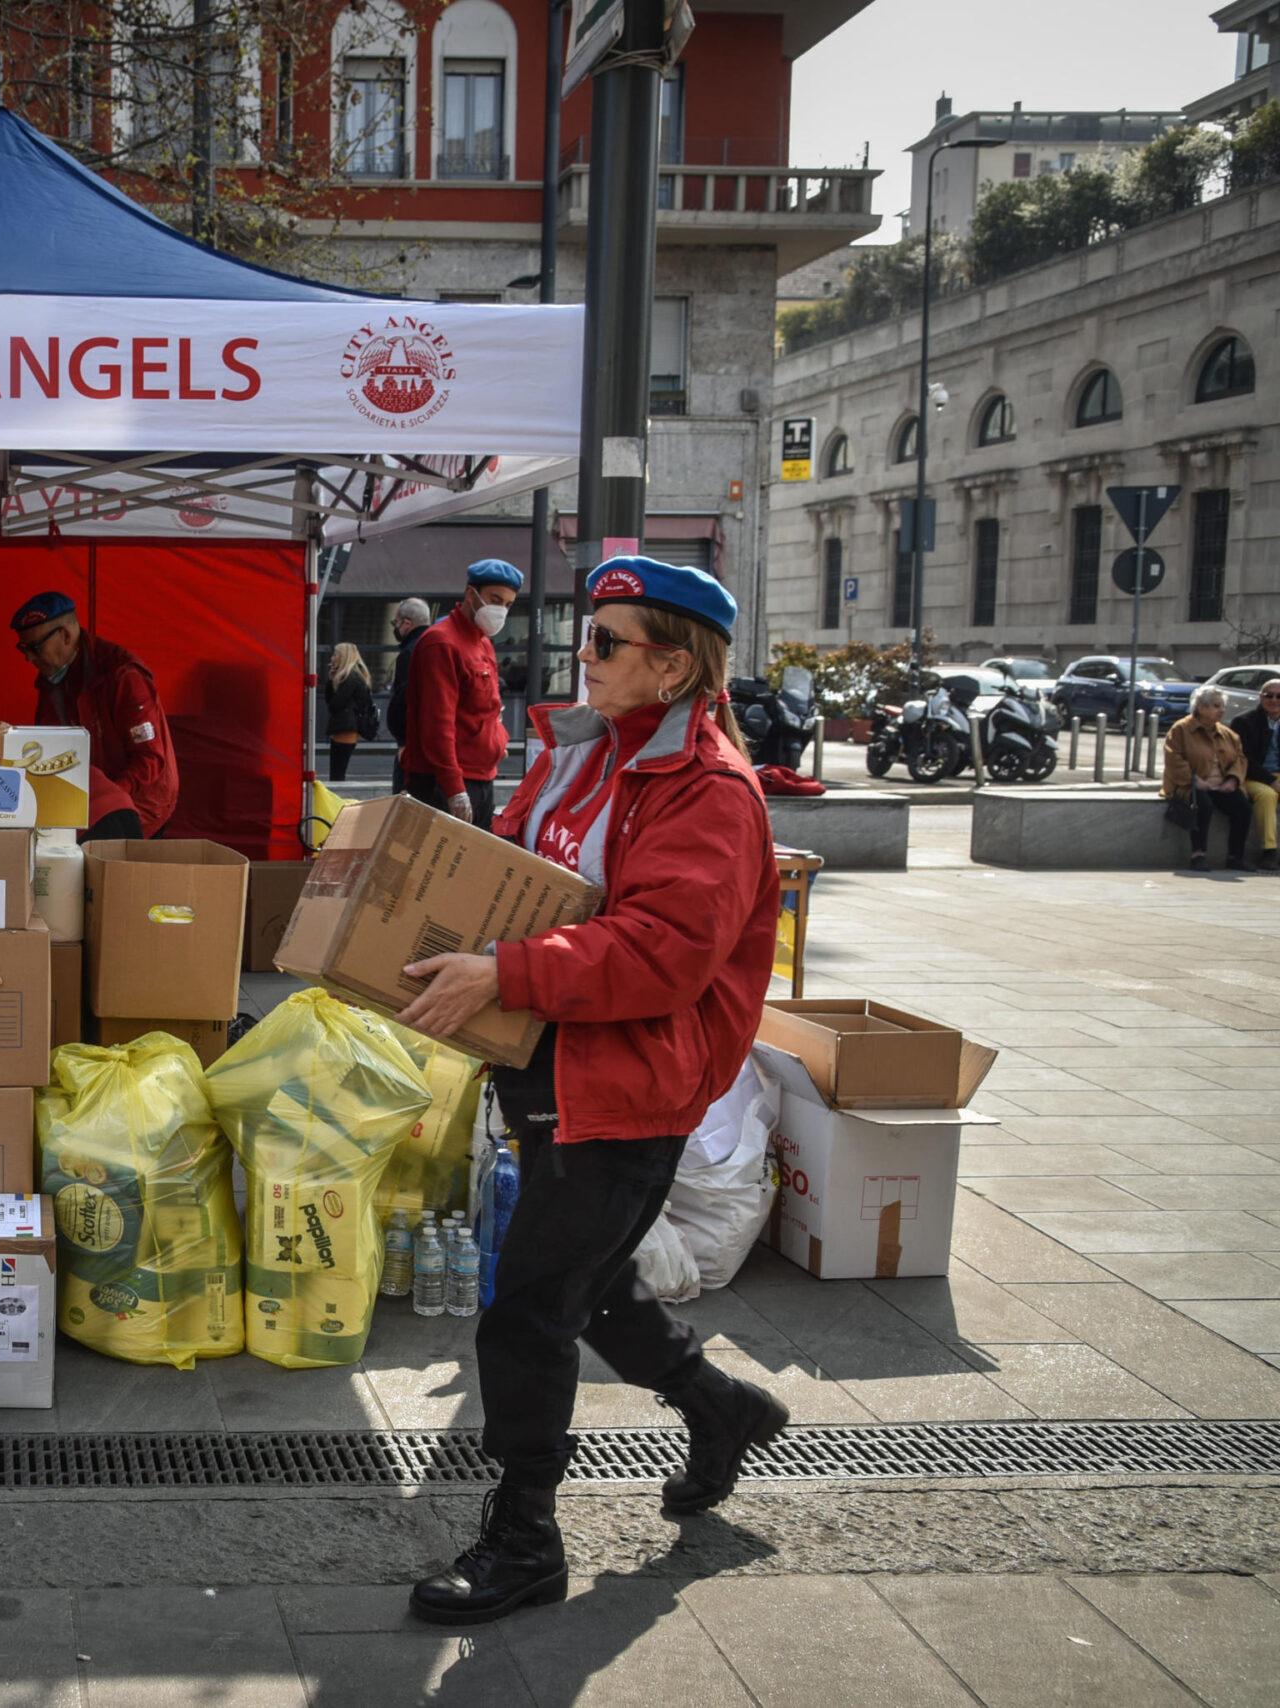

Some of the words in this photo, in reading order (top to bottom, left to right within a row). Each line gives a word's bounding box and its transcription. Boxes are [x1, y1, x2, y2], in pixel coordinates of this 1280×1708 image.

[341, 321, 373, 379] CITY
[385, 316, 456, 381] ANGELS
[408, 388, 451, 428] SICUREZZA
[789, 422, 808, 442] T
[593, 575, 608, 595] CITY
[611, 573, 640, 593] ANGELS
[543, 821, 580, 865] ANG
[478, 902, 497, 935] diamond
[273, 1184, 281, 1199] 50
[80, 1191, 97, 1246] Scottex
[299, 1203, 336, 1269] papillon
